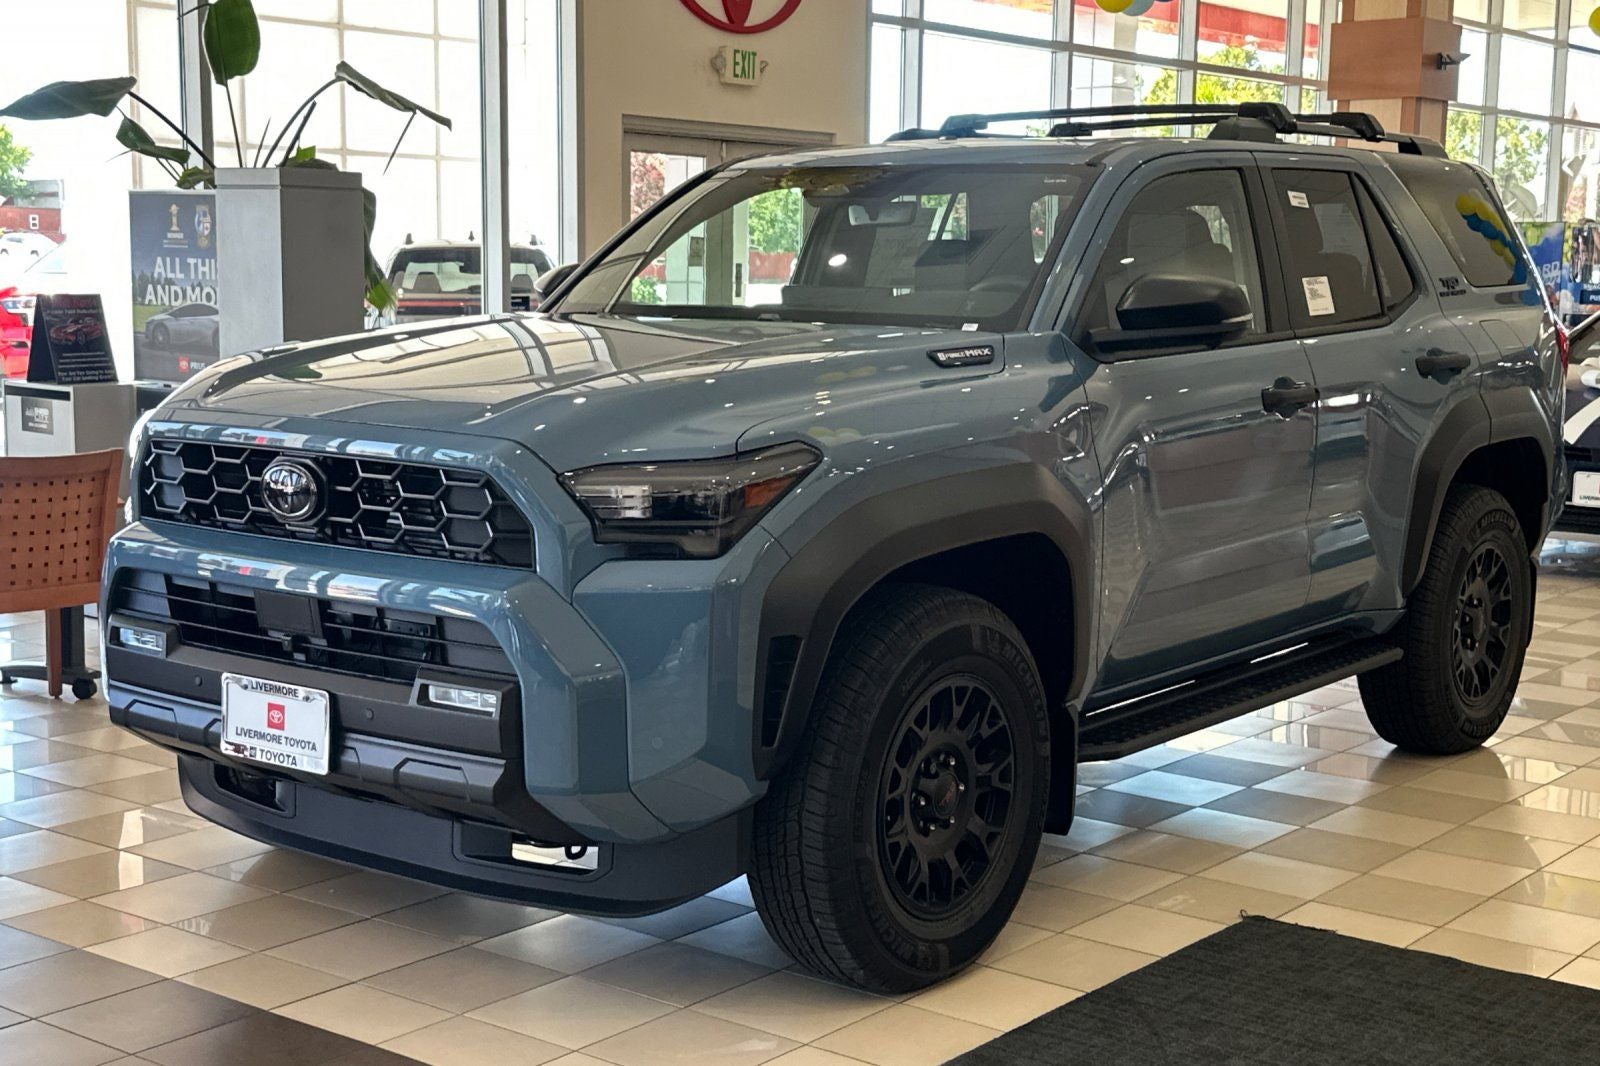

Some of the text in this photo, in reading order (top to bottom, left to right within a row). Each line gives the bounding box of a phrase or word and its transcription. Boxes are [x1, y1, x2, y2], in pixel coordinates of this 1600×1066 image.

[733, 49, 757, 80] EXIT
[154, 256, 217, 280] ALL THI
[145, 284, 217, 306] AND MO
[965, 348, 992, 358] MAX
[251, 681, 299, 697] LIVERMORE
[235, 726, 317, 752] LIVERMORE TOYOTA
[259, 749, 298, 767] TOYOTA
